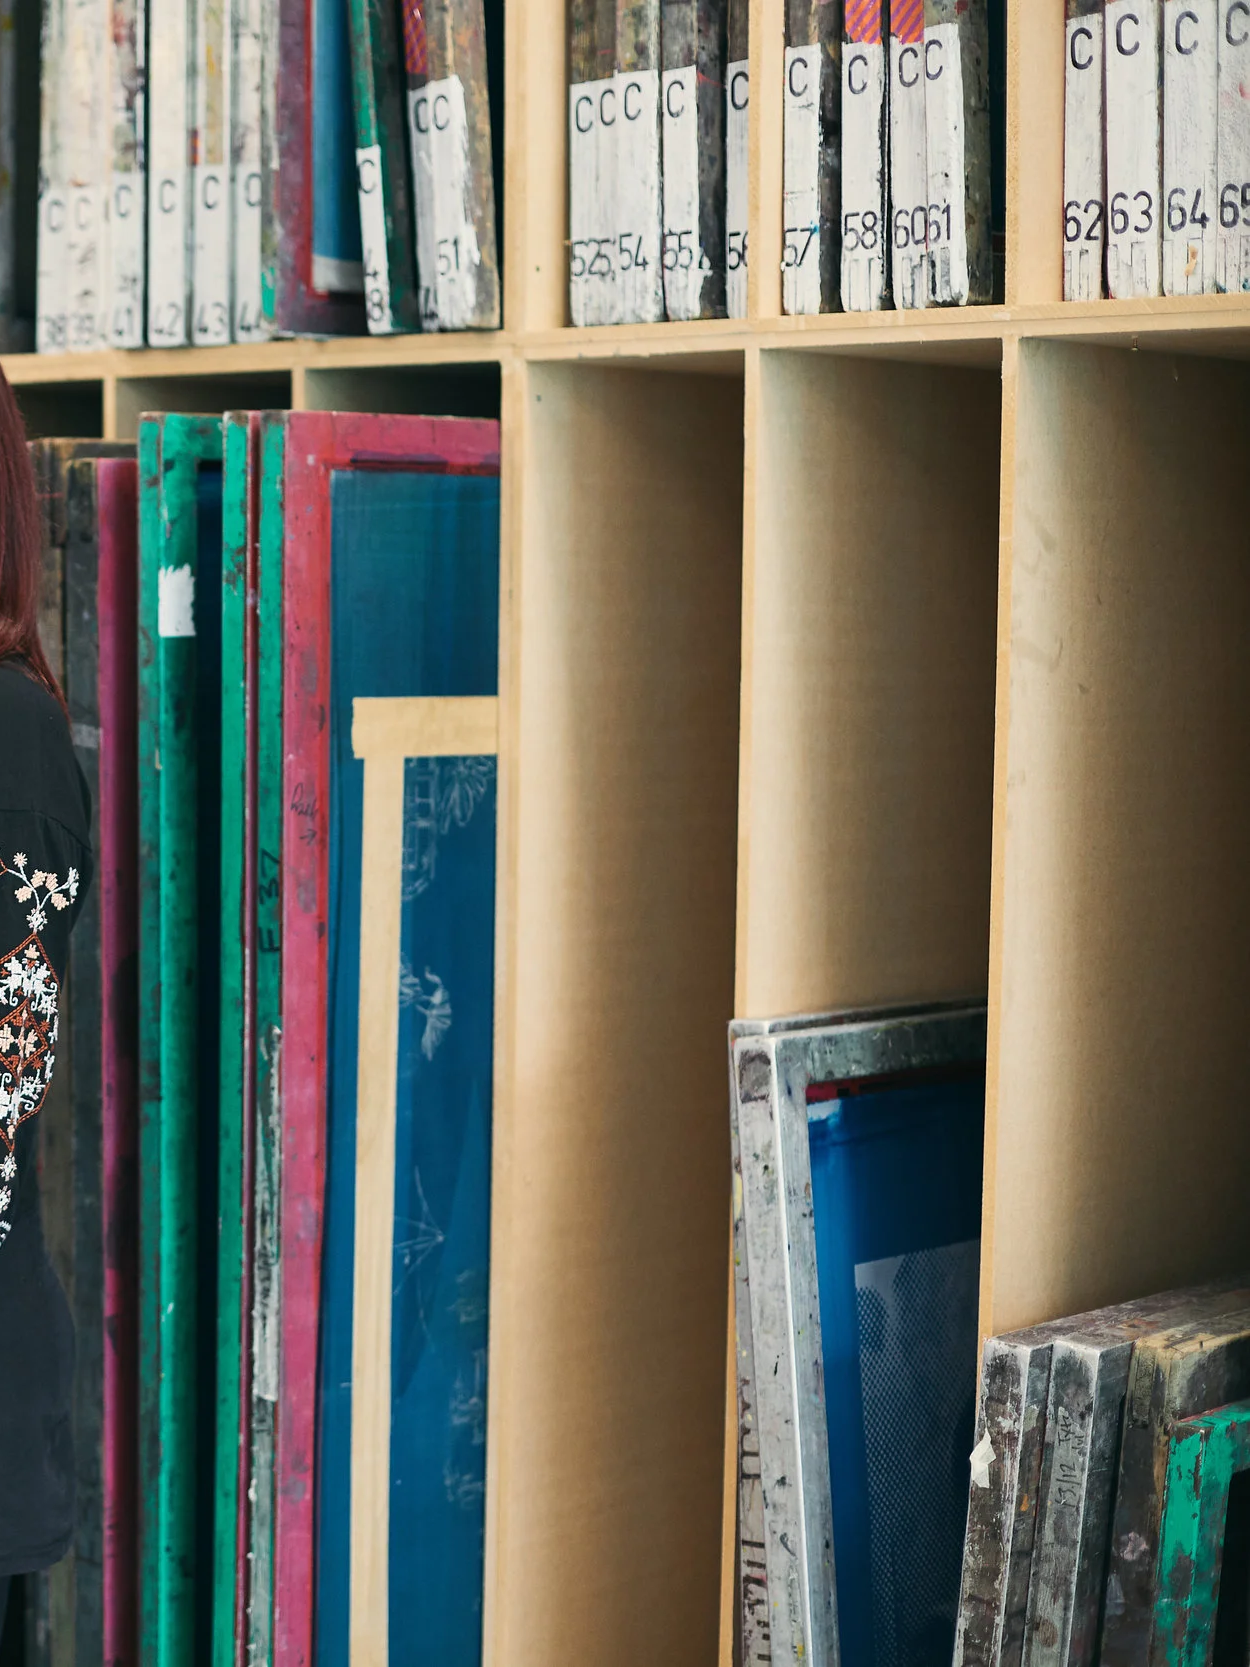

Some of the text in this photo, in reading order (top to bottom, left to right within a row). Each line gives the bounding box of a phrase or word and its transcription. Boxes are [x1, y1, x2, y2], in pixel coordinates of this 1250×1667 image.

[1115, 12, 1140, 56] C
[1174, 10, 1199, 56] C
[1225, 0, 1250, 47] C
[899, 46, 919, 88] C
[924, 38, 944, 81] C
[1070, 26, 1094, 70] C
[730, 71, 749, 111] C
[788, 57, 808, 98] C
[848, 54, 868, 95] C
[433, 95, 450, 130] C
[575, 96, 593, 133] C
[600, 88, 616, 126] C
[624, 82, 641, 121] C
[666, 80, 685, 118] C
[159, 179, 176, 213] C
[203, 175, 220, 209] C
[358, 159, 377, 194] C
[115, 184, 132, 219] C
[1064, 198, 1104, 242] 62
[1110, 190, 1153, 235] 63
[1167, 187, 1211, 232] 64
[844, 210, 878, 252] 58
[893, 205, 927, 249] 60
[927, 203, 951, 244] 61
[438, 235, 459, 276] 51
[619, 232, 649, 271] 54
[663, 229, 693, 270] 55
[783, 225, 817, 268] 57
[153, 302, 181, 337] 42
[198, 302, 227, 337] 43
